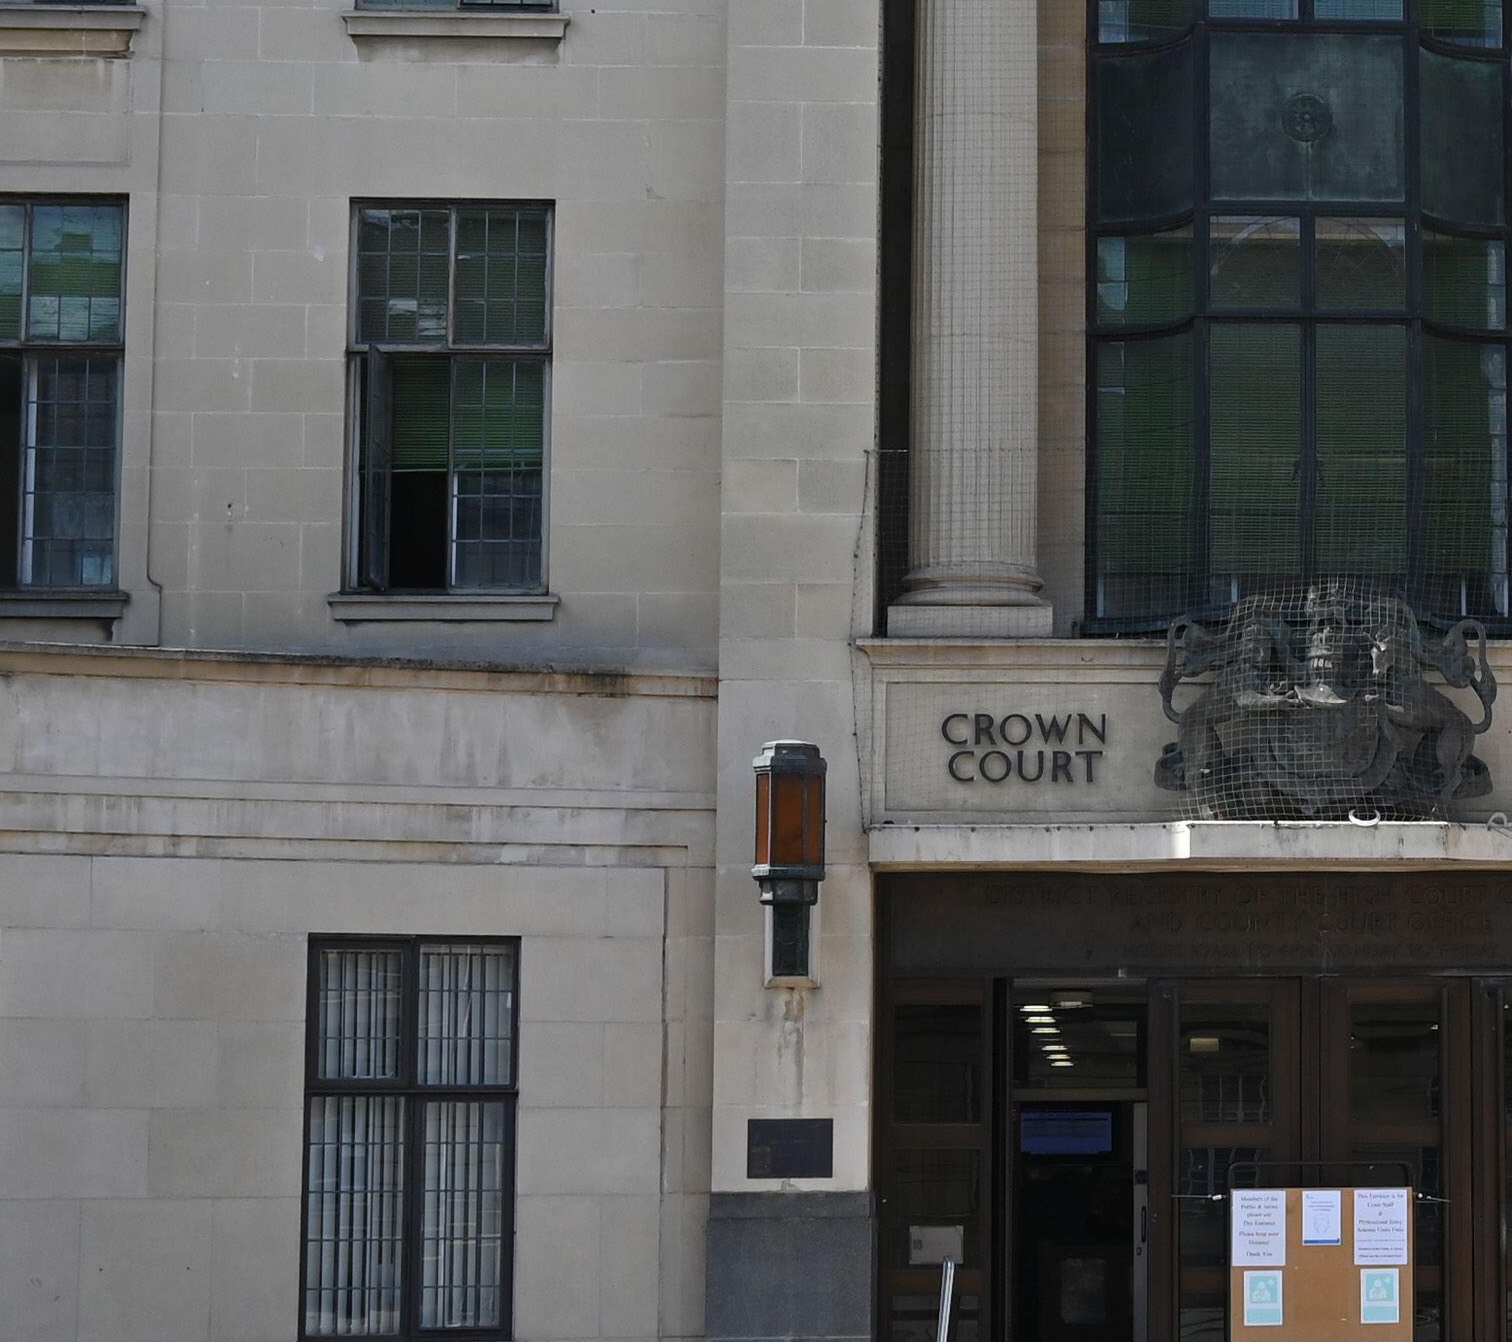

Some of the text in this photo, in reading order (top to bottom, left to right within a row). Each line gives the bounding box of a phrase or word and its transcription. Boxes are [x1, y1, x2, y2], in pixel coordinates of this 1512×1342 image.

[941, 713, 1106, 746] CROWN
[948, 750, 1103, 783] COURT
[985, 884, 1096, 906] DISTRICT
[1109, 884, 1224, 906] REGISTRY
[1235, 884, 1268, 906] OF
[1280, 884, 1325, 906] THE
[1336, 884, 1392, 906] HIGH
[1405, 884, 1488, 906] COURT
[1129, 911, 1494, 933] AND COUNTY COURT OFFICE
